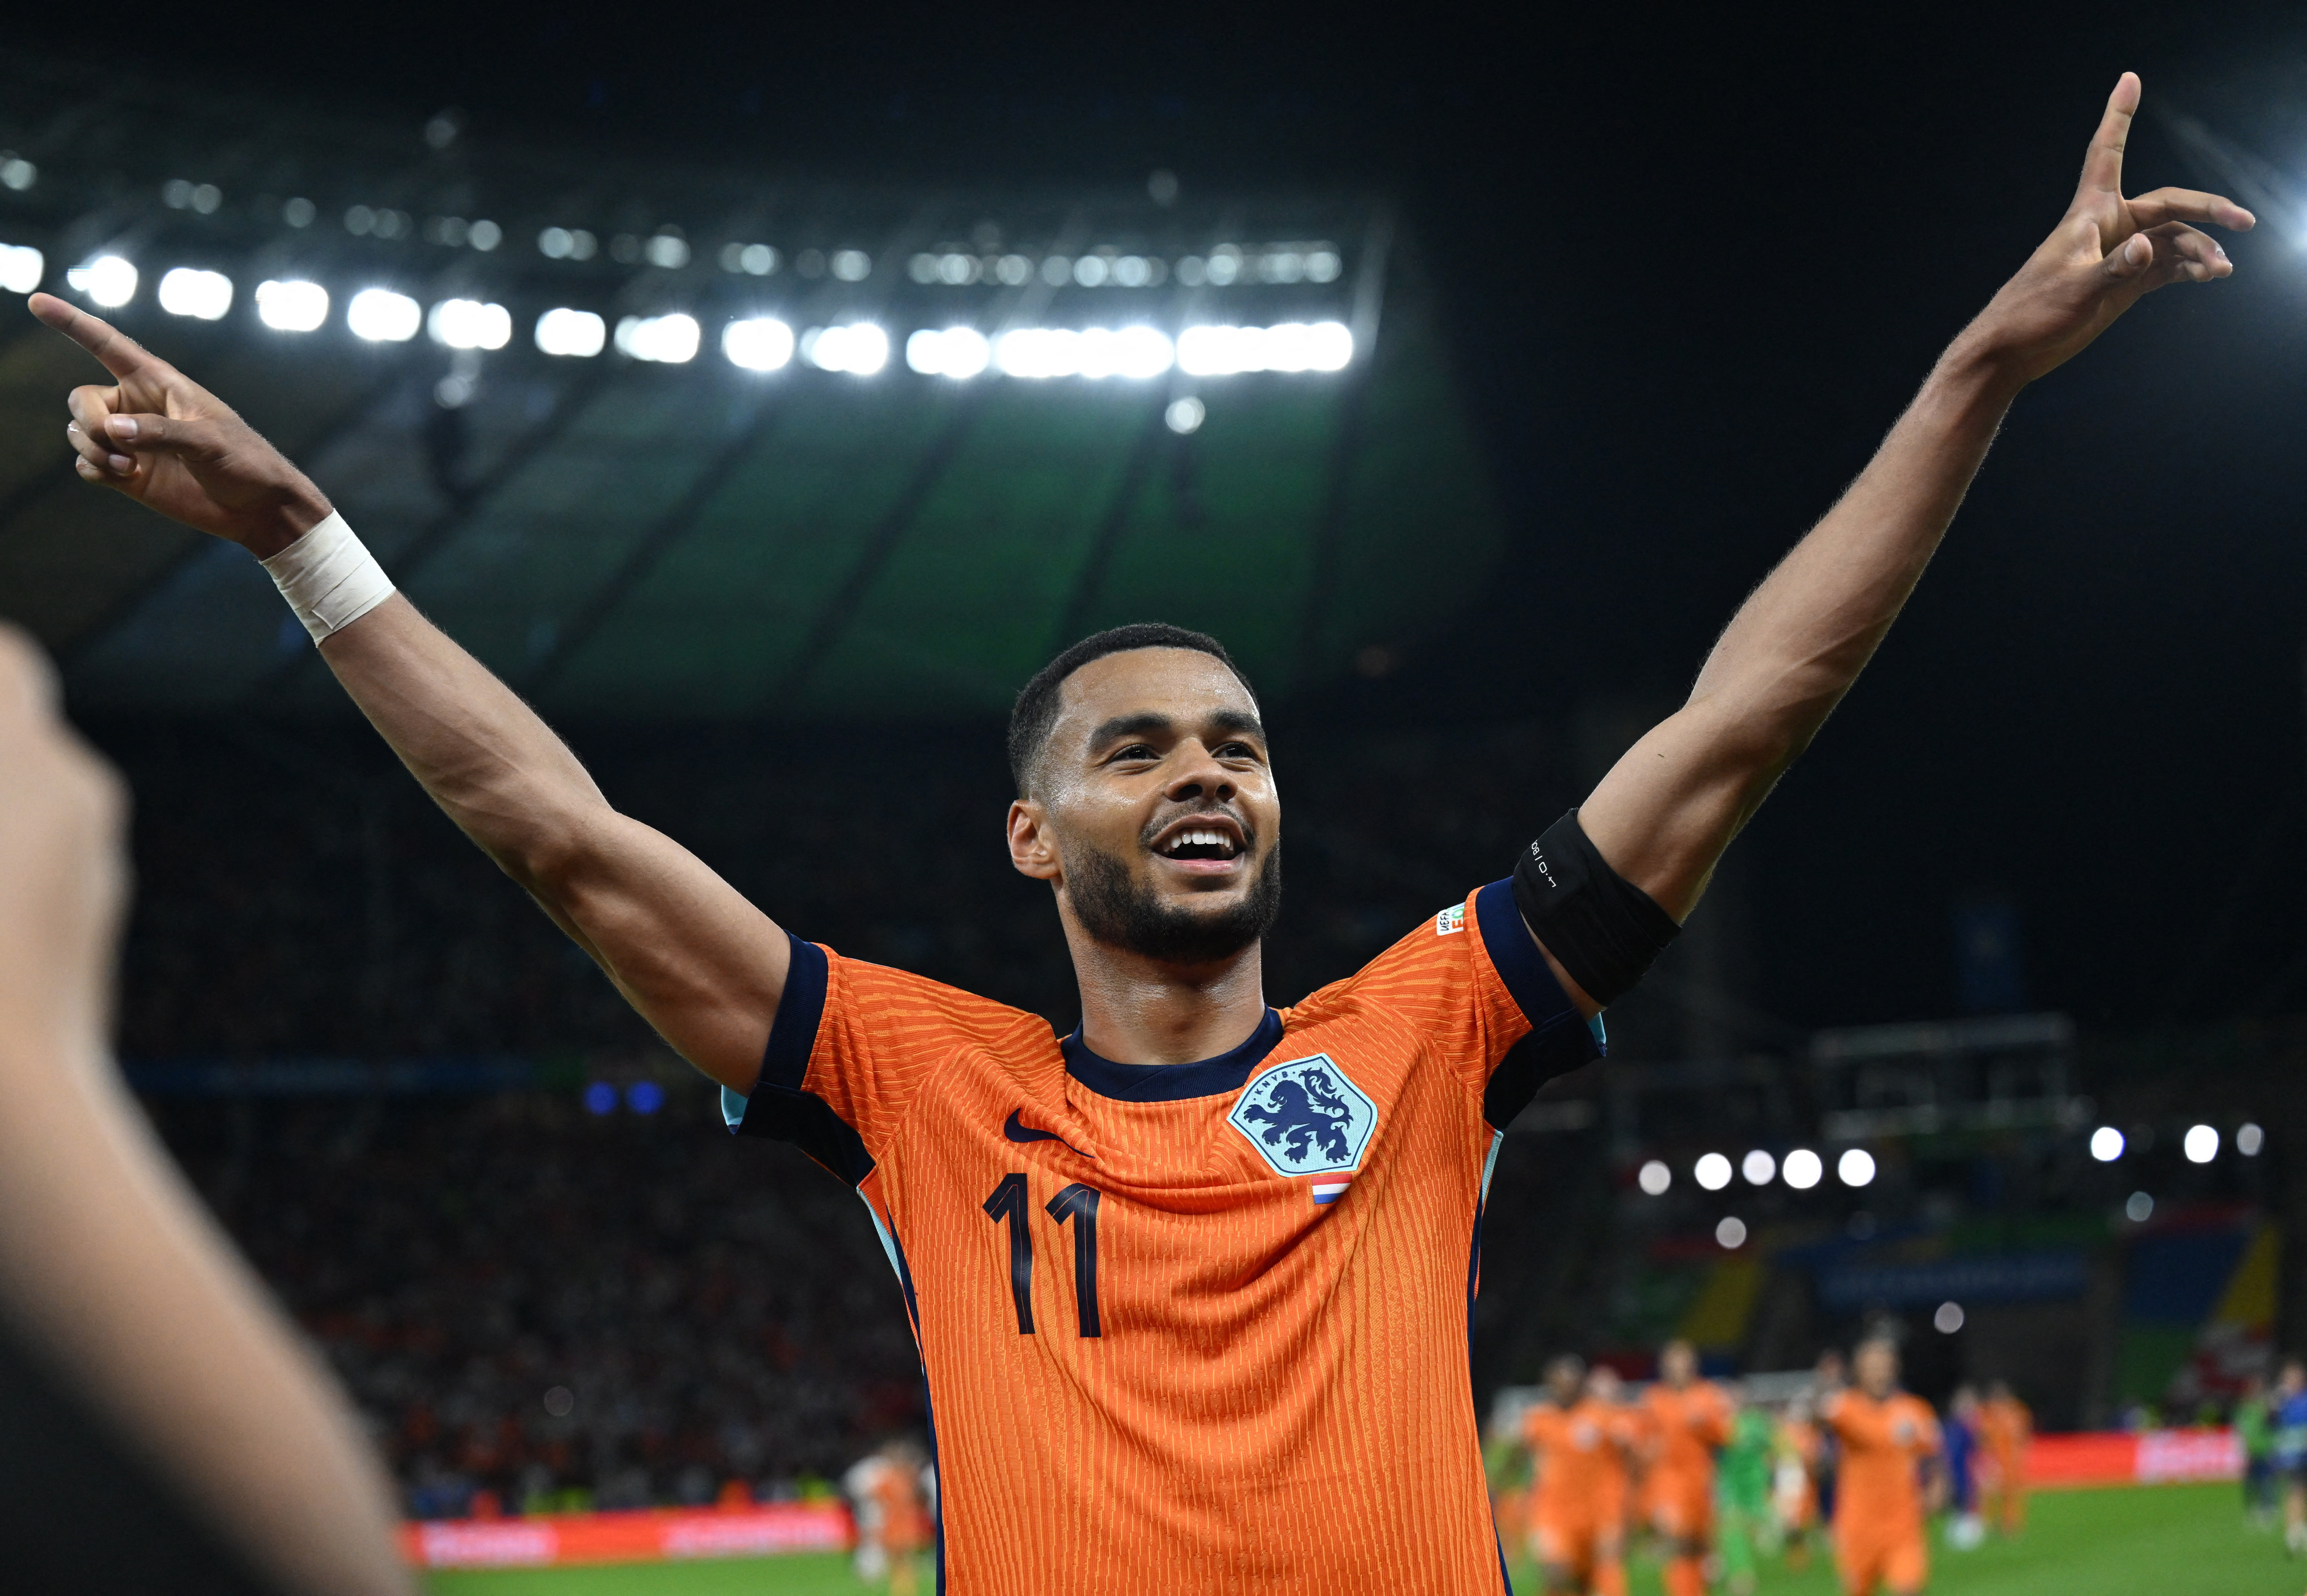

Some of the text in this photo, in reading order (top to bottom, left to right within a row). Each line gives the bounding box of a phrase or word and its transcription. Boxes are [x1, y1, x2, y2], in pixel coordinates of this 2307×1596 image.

[1440, 911, 1449, 931] UEFA
[1254, 1071, 1288, 1095] KNVB
[982, 1173, 1101, 1337] 11
